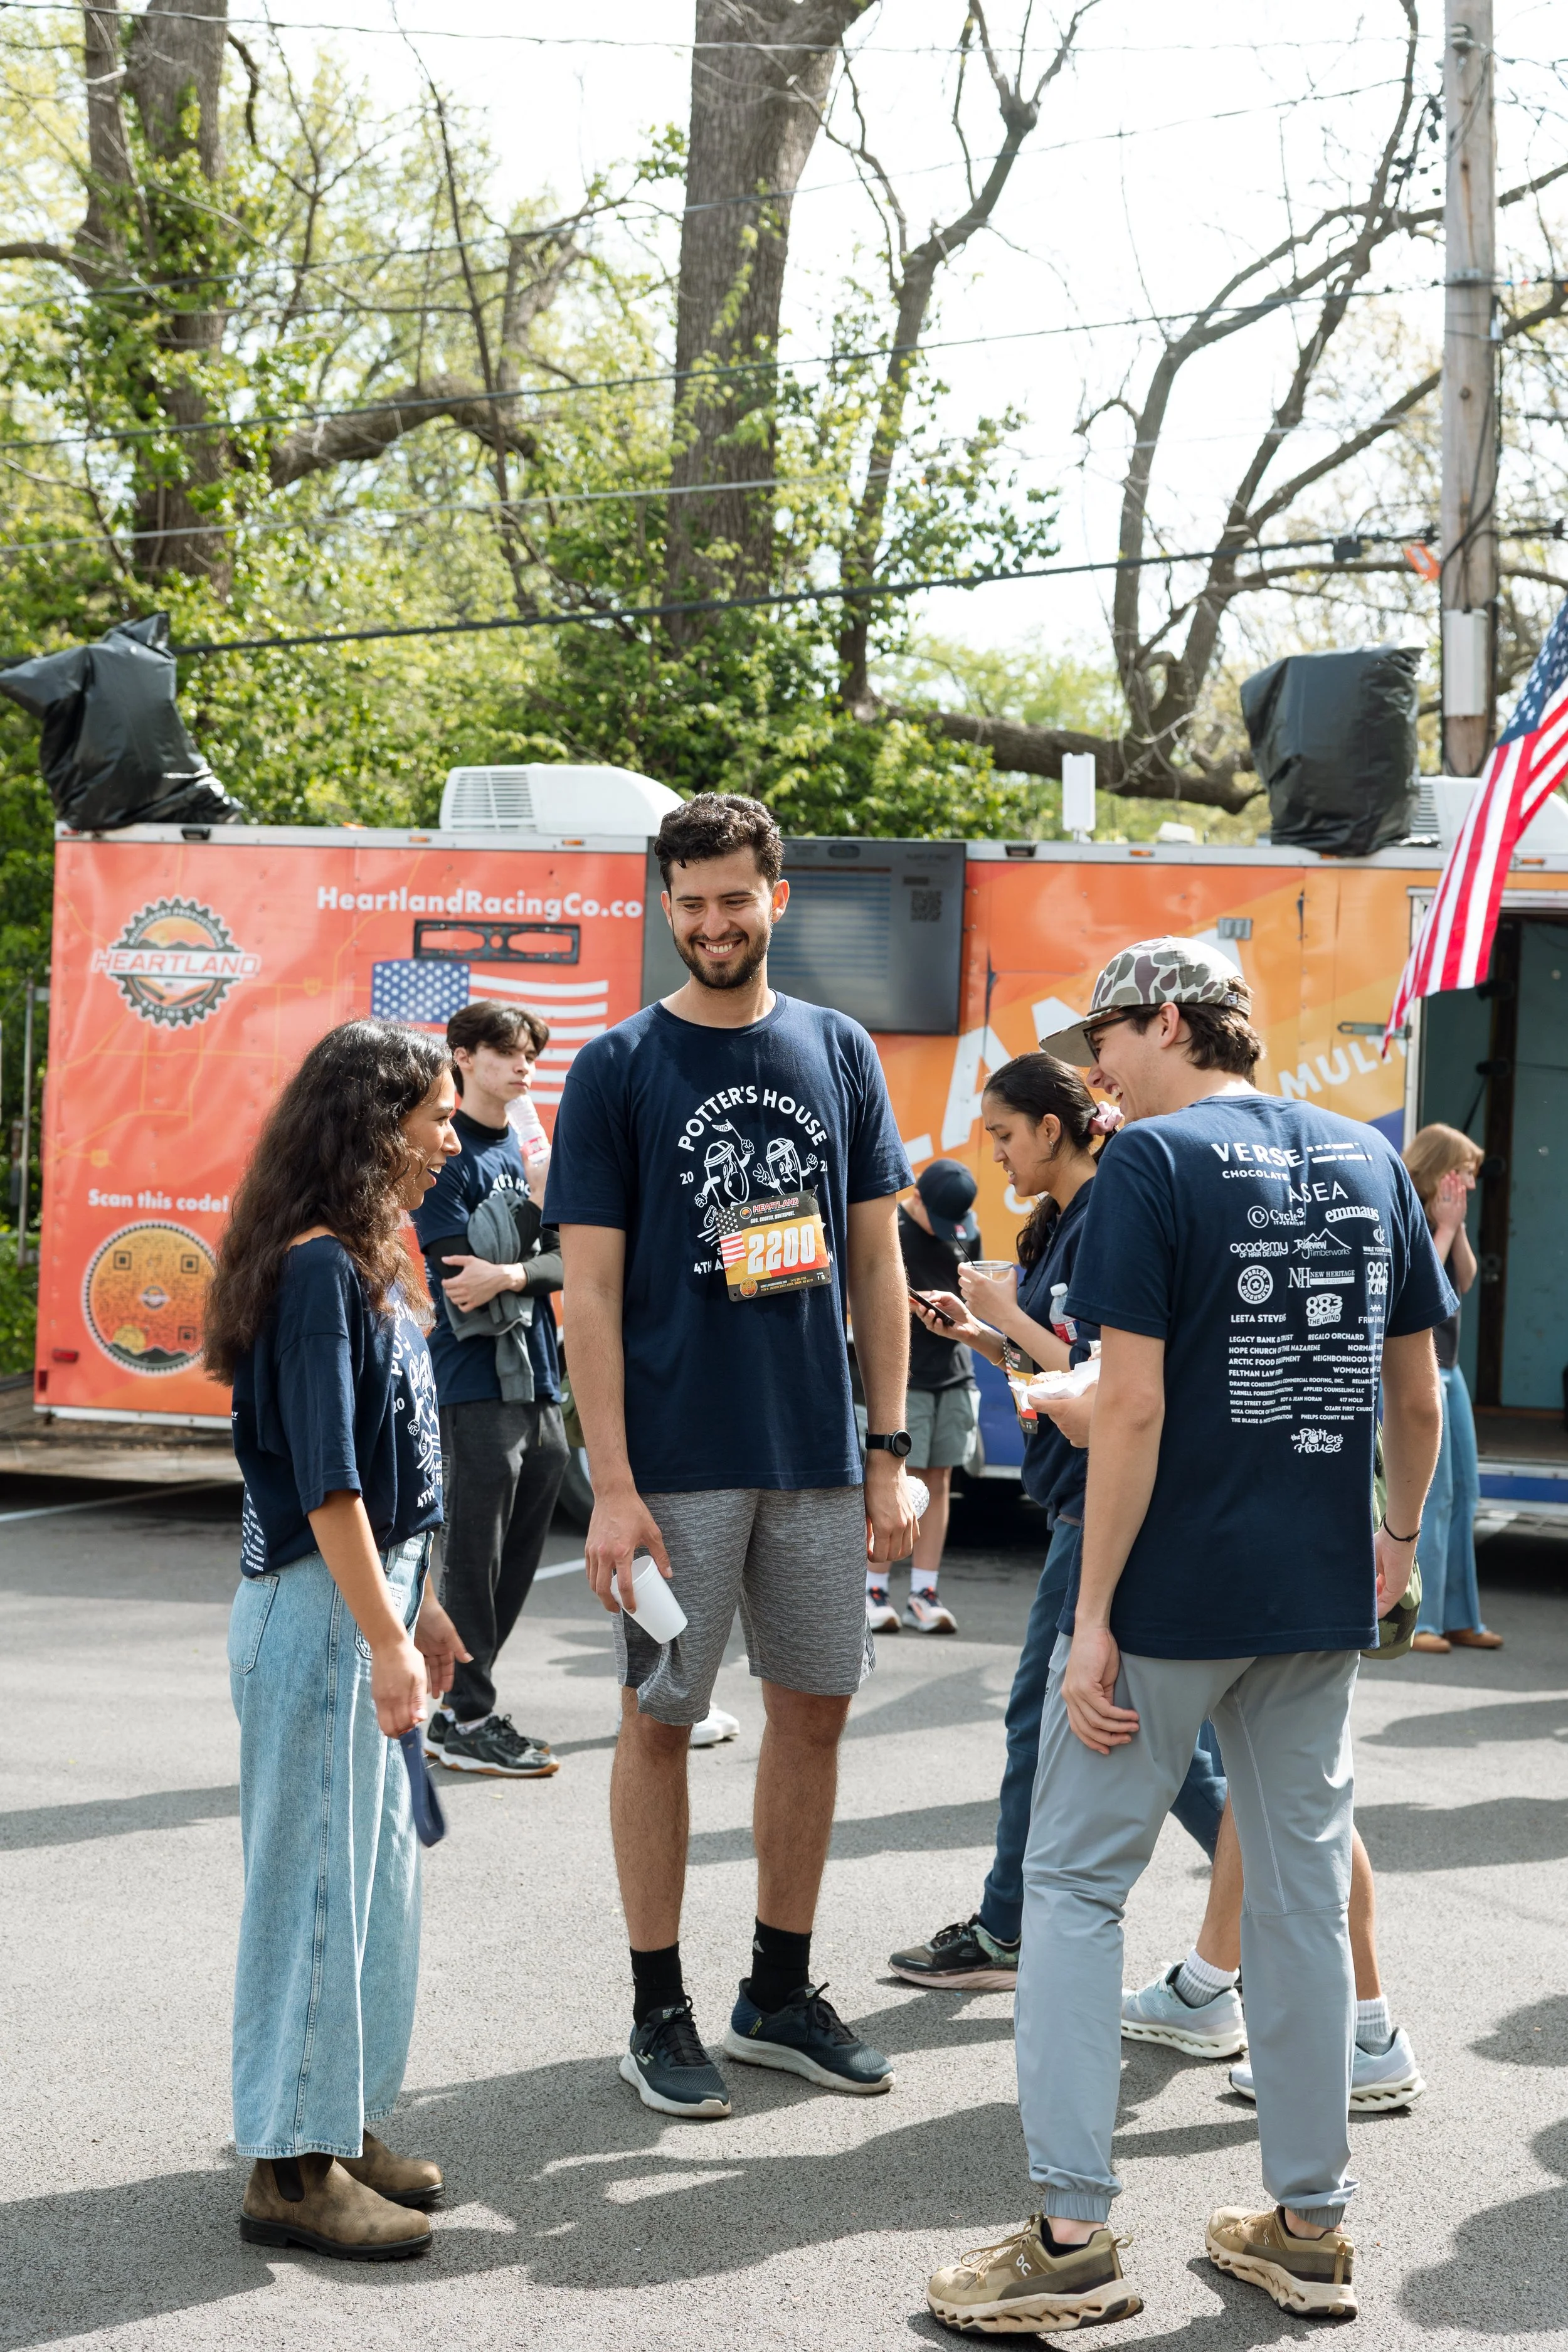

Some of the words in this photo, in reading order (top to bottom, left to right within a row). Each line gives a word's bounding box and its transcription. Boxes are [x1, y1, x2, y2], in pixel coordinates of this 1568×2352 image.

[94, 952, 259, 975] HEARTLAND
[678, 1085, 758, 1152] POTTER'S
[763, 1089, 827, 1147] HOUSE
[1210, 1142, 1305, 1168] VERSE
[679, 1170, 694, 1185] 20
[1222, 1169, 1291, 1182] CHOCOLATE
[1289, 1180, 1349, 1204] ASEA
[88, 1188, 134, 1208] Scan
[137, 1190, 173, 1210] this
[176, 1193, 230, 1213] code!
[753, 1197, 799, 1213] HEARTLAND
[1325, 1205, 1380, 1223] emmaus
[747, 1224, 816, 1275] 2200
[1229, 1239, 1289, 1255] academy
[1310, 1248, 1350, 1257] Timberworks
[694, 1259, 712, 1274] 4TH
[1244, 1269, 1268, 1280] PARLOR
[1231, 1314, 1256, 1323] LEETA
[1322, 1314, 1340, 1323] WIND
[1308, 1333, 1330, 1341] REGALO
[1249, 1347, 1277, 1355] CHURCH
[1313, 1355, 1367, 1363] NEIGHBORHOOD
[1228, 1369, 1260, 1377] FELTMAN
[1332, 1366, 1369, 1374] WOMMACK
[1293, 1441, 1342, 1454] House
